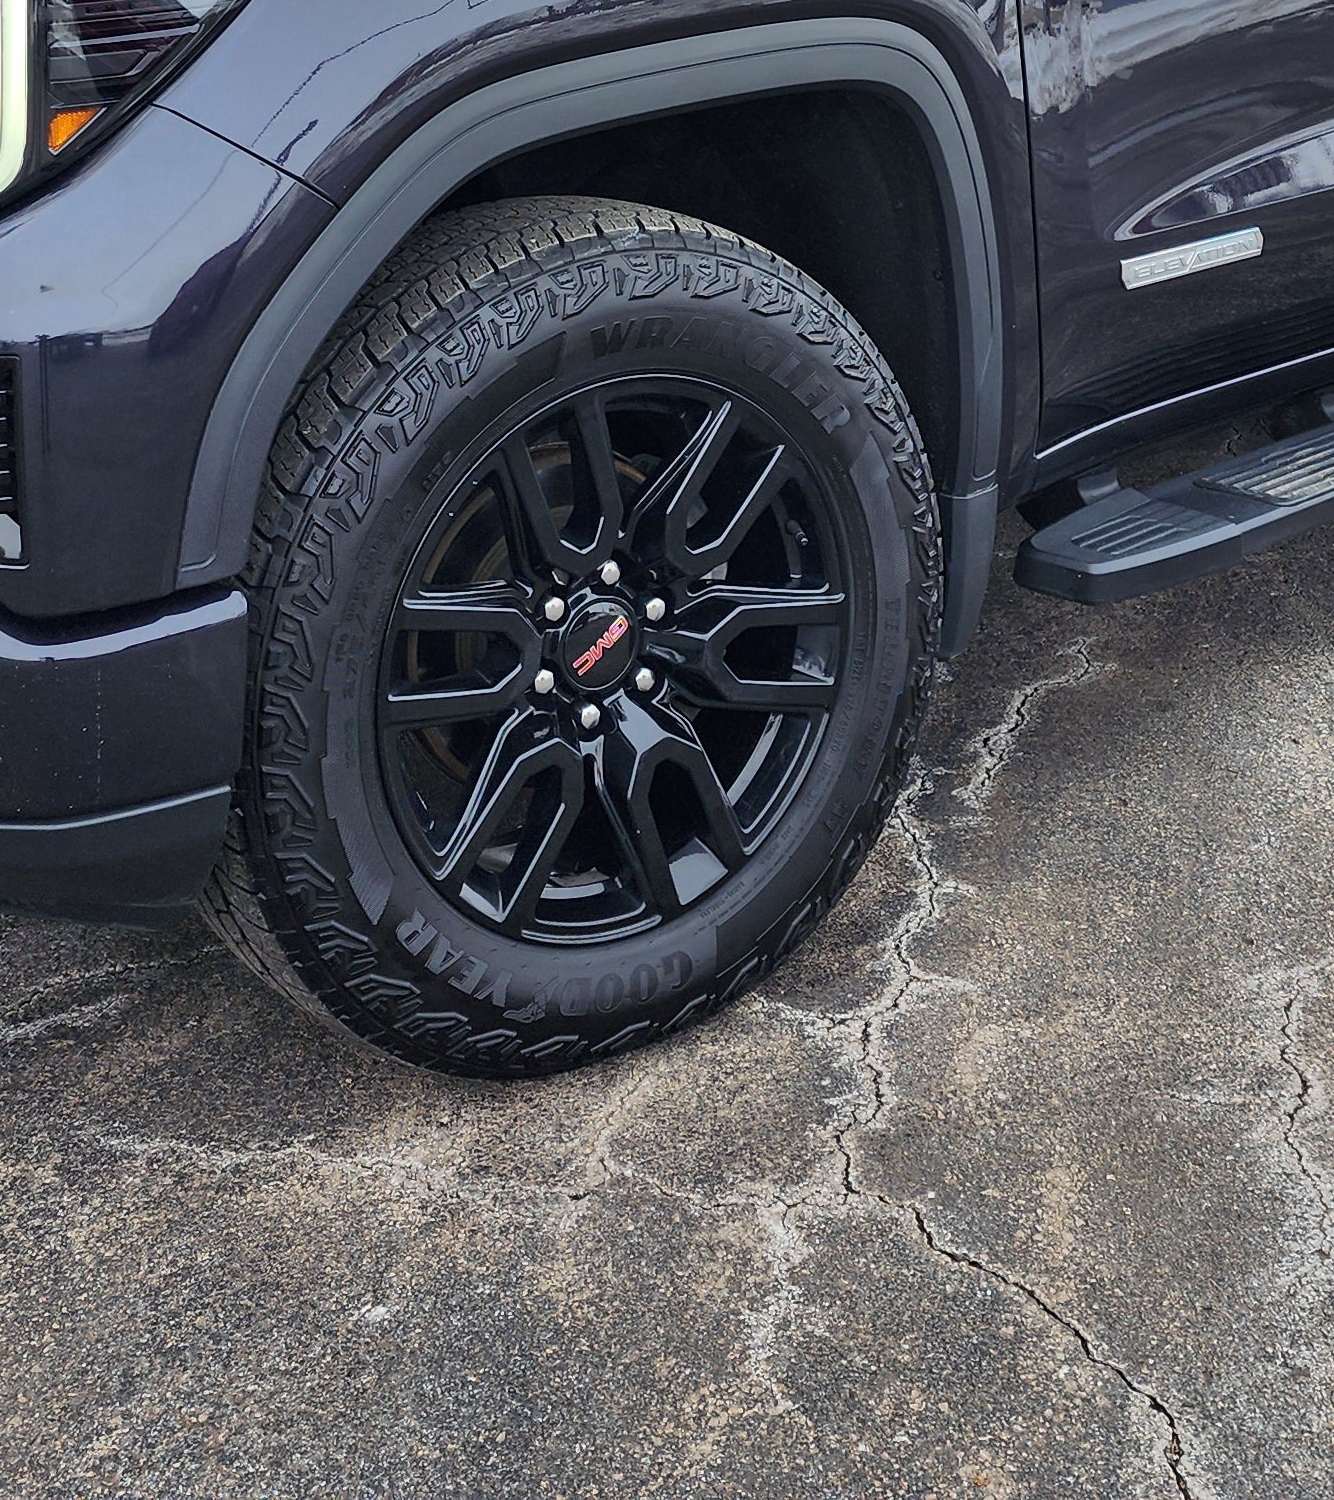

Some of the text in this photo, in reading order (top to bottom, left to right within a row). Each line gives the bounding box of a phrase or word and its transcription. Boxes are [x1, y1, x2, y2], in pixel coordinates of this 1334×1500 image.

[1134, 237, 1255, 278] ELEVATION
[590, 315, 851, 435] WRANGLER
[572, 615, 629, 676] GMC
